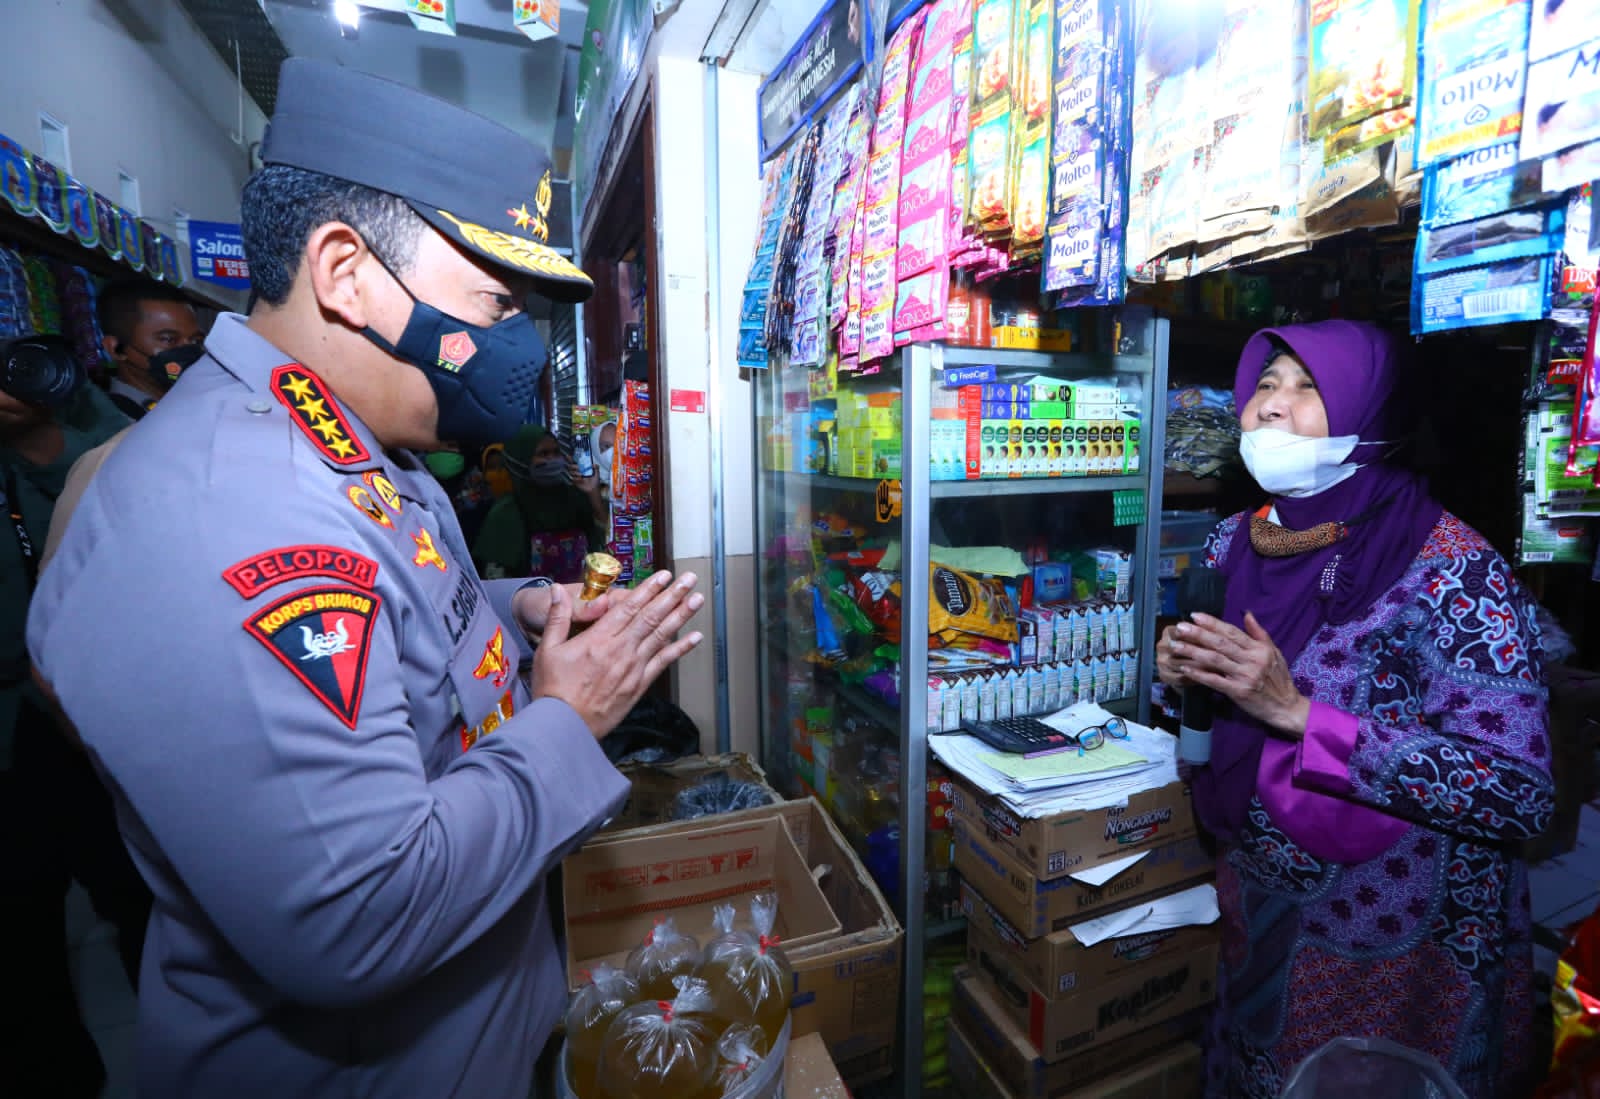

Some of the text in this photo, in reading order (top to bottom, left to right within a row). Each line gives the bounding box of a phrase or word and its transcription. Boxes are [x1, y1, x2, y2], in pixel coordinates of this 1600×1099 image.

[1063, 8, 1093, 38] Molto
[1441, 69, 1519, 106] Molto
[1060, 87, 1092, 113] Molto
[1058, 164, 1091, 185] Molto
[868, 213, 889, 228] Molto
[1053, 239, 1089, 257] Molto
[866, 268, 887, 282] Molto
[865, 321, 885, 336] Molto
[236, 551, 369, 588] PELOPOR
[255, 593, 372, 634] KORPS BRIMOB
